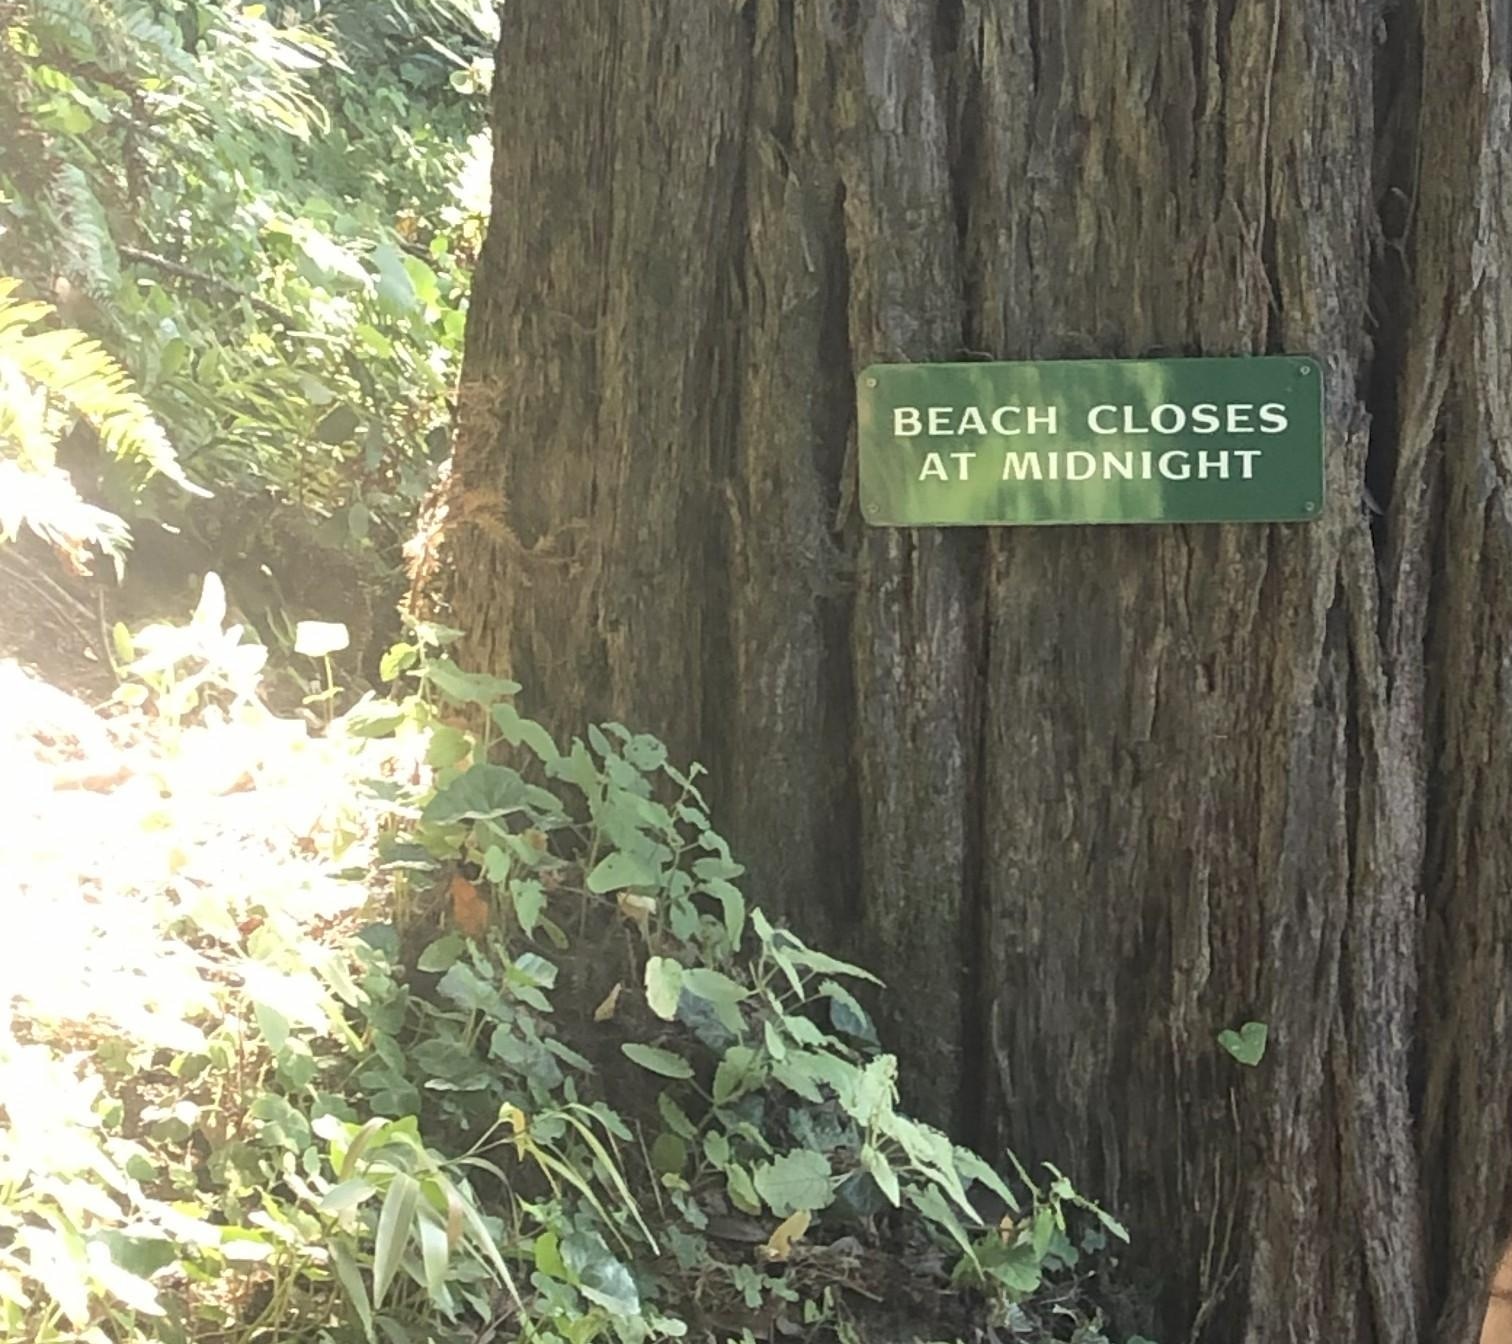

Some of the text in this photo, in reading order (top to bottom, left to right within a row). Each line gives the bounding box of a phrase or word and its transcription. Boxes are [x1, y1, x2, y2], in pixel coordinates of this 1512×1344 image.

[893, 402, 1288, 436] BEACH CLOSES
[919, 449, 1262, 481] AT MIDNIGHT
